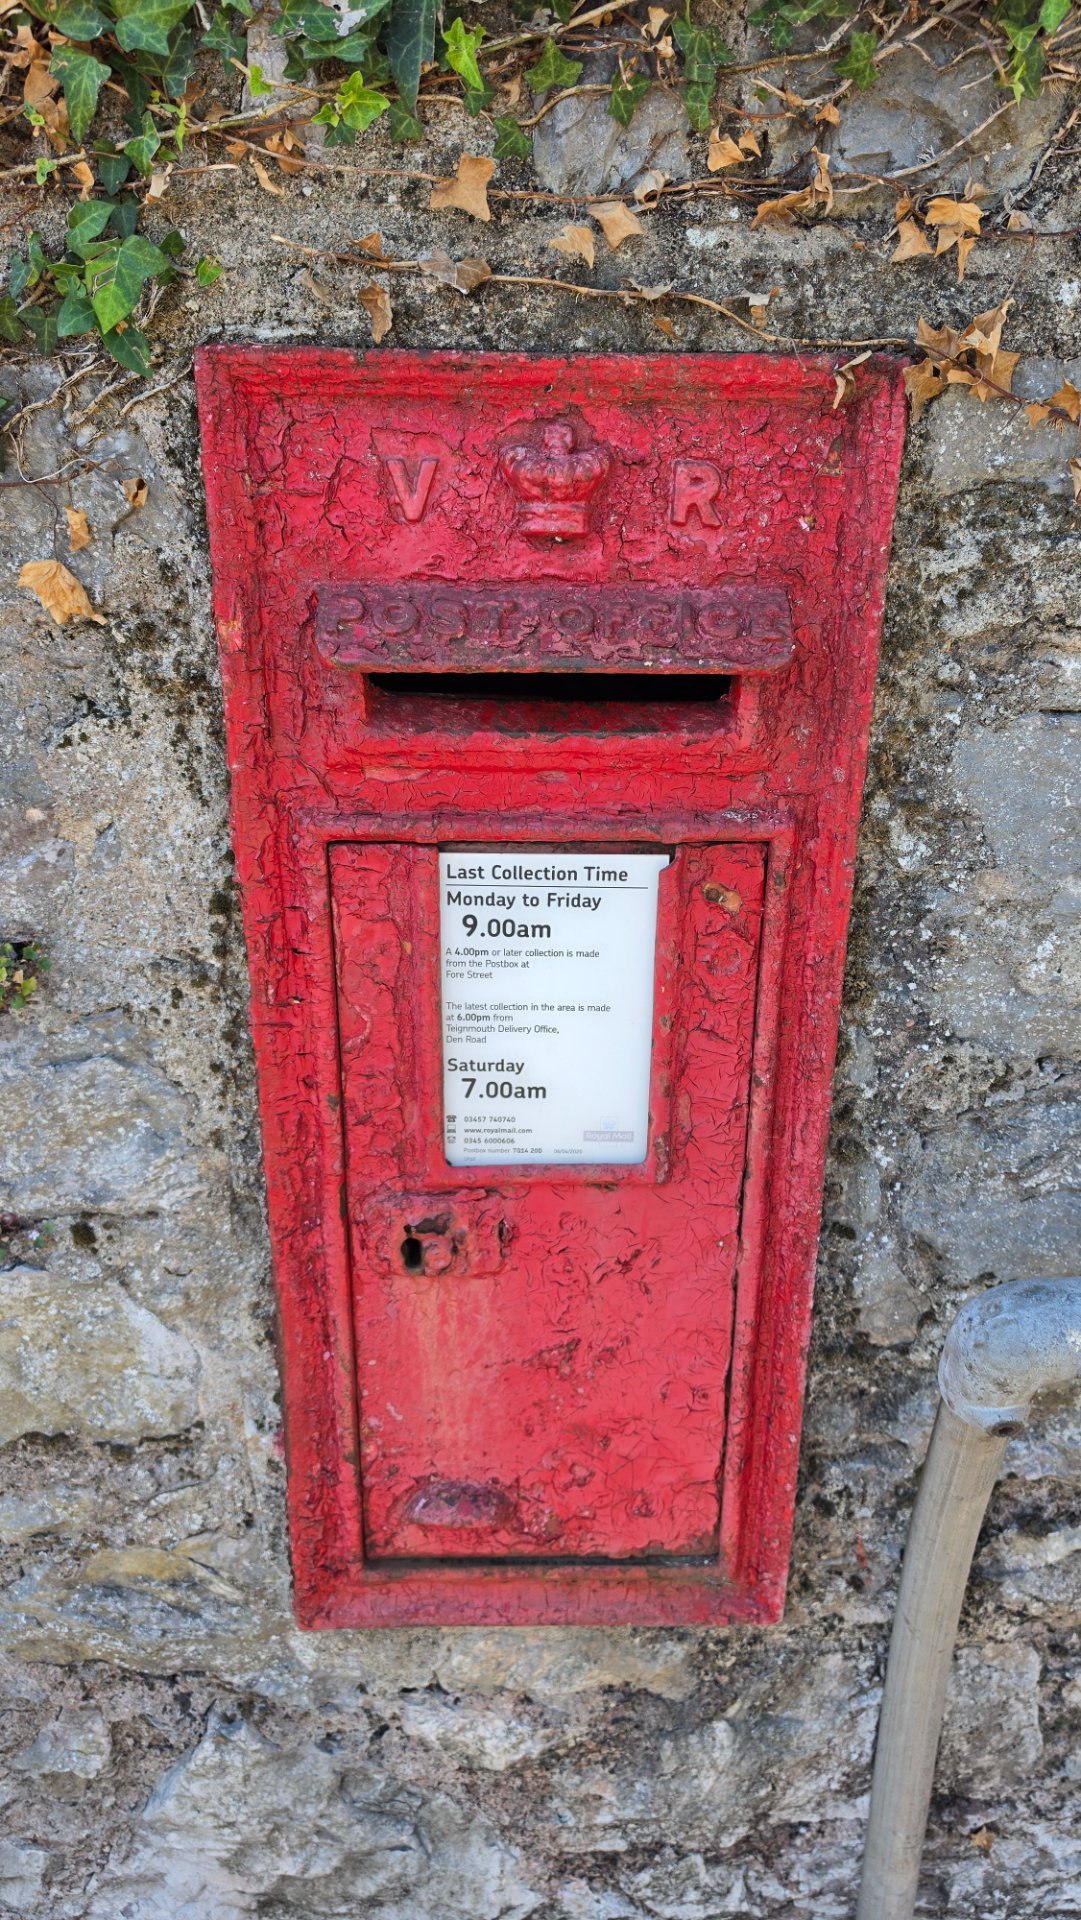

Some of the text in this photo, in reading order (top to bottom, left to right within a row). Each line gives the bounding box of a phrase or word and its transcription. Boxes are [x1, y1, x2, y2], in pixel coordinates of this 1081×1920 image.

[386, 458, 723, 527] V R
[322, 596, 517, 644] POST
[446, 864, 628, 882] Last Collection Time
[447, 891, 601, 910] Monday to Friday
[462, 914, 551, 938] 9.00am
[446, 947, 452, 955] A
[454, 948, 489, 957] 4.00pm
[503, 949, 522, 957] later
[525, 949, 564, 957] collection
[576, 950, 600, 958] made
[446, 960, 530, 969] from the Postbox at
[467, 971, 493, 979] Street
[446, 1002, 462, 1011] The
[464, 1002, 488, 1011] latest
[489, 1003, 528, 1011] collection
[530, 1003, 539, 1011] in
[578, 1004, 585, 1012] is
[587, 1004, 611, 1012] made
[456, 1013, 491, 1023] 6.00pm
[492, 1014, 514, 1022] from
[446, 1024, 560, 1035] Teignmouth Delivery Office,
[446, 1036, 487, 1044] Den Road
[447, 1058, 525, 1075] Saturday
[461, 1078, 547, 1099] 7.00am
[464, 1127, 533, 1135] www.royalmail.com
